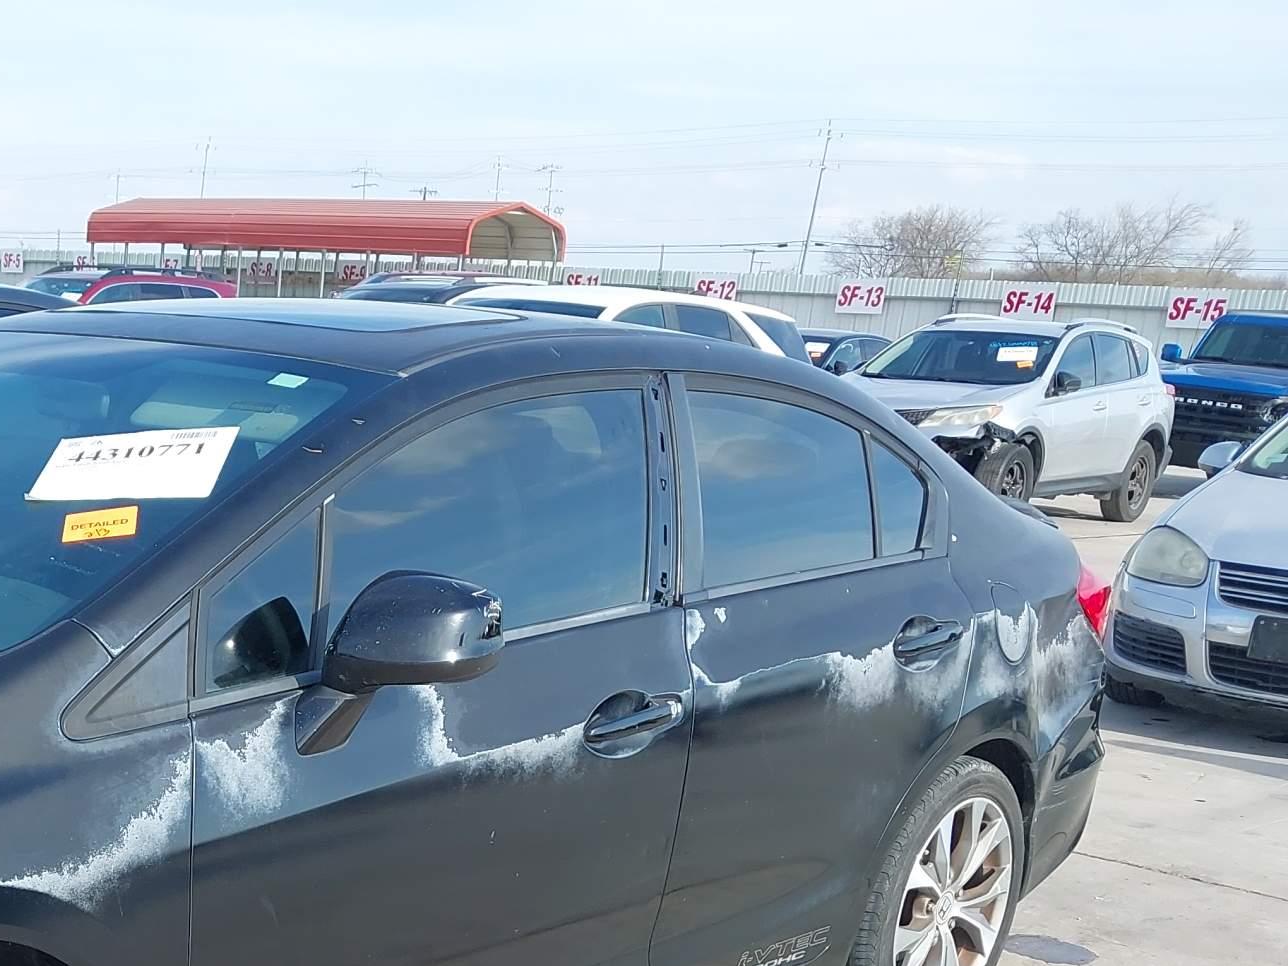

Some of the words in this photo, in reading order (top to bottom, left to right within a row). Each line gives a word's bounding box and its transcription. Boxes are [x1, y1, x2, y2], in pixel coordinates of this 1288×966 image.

[3, 252, 21, 268] SF-5
[697, 279, 737, 300] SF-12
[837, 284, 884, 308] SF-13
[1003, 290, 1055, 315] SF-14
[1168, 297, 1227, 322] SF-15
[1174, 396, 1243, 410] RONCO
[68, 442, 205, 463] 44310771
[70, 517, 129, 531] DETAILED
